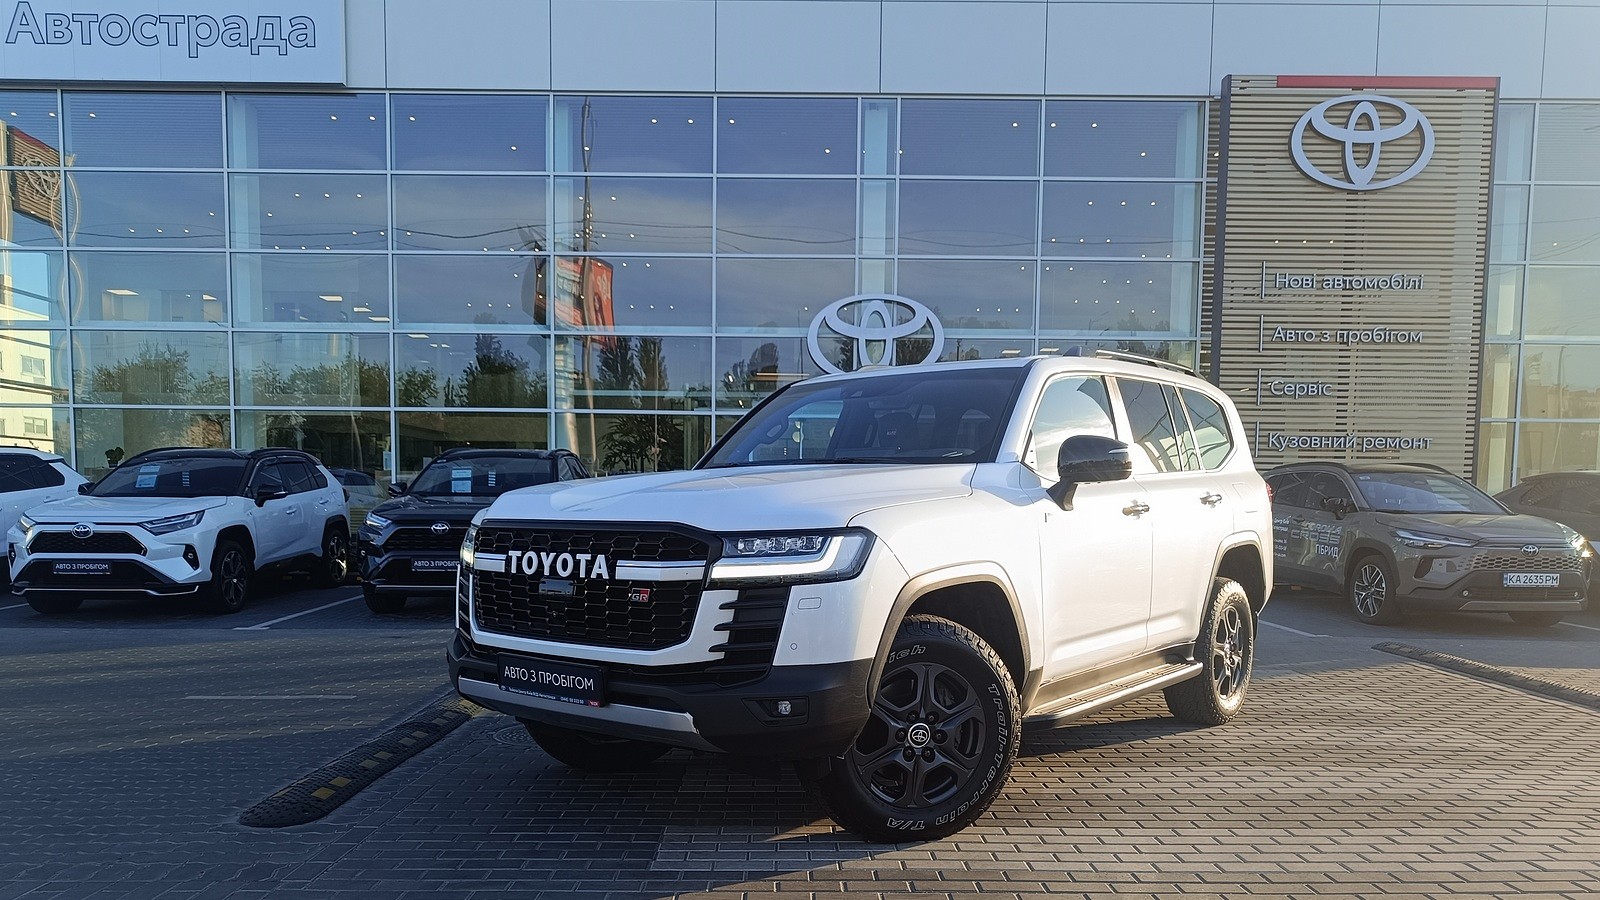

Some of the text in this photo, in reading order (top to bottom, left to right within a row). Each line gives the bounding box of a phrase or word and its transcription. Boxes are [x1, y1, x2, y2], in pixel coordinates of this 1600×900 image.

[5, 1, 316, 58] Автострада
[1274, 272, 1425, 290] Нові автомобілі
[1271, 326, 1423, 347] Авто з пробігом
[1269, 379, 1333, 399] Сервіс
[1268, 432, 1433, 452] Кузовний ремонт
[1290, 529, 1341, 545] CROSS
[508, 550, 610, 580] TOYOTA
[1523, 574, 1544, 584] 2635
[888, 644, 926, 664] ich
[504, 665, 529, 681] АВТО
[538, 671, 595, 691] ПРОБІГОМ
[886, 817, 925, 831] T/A
